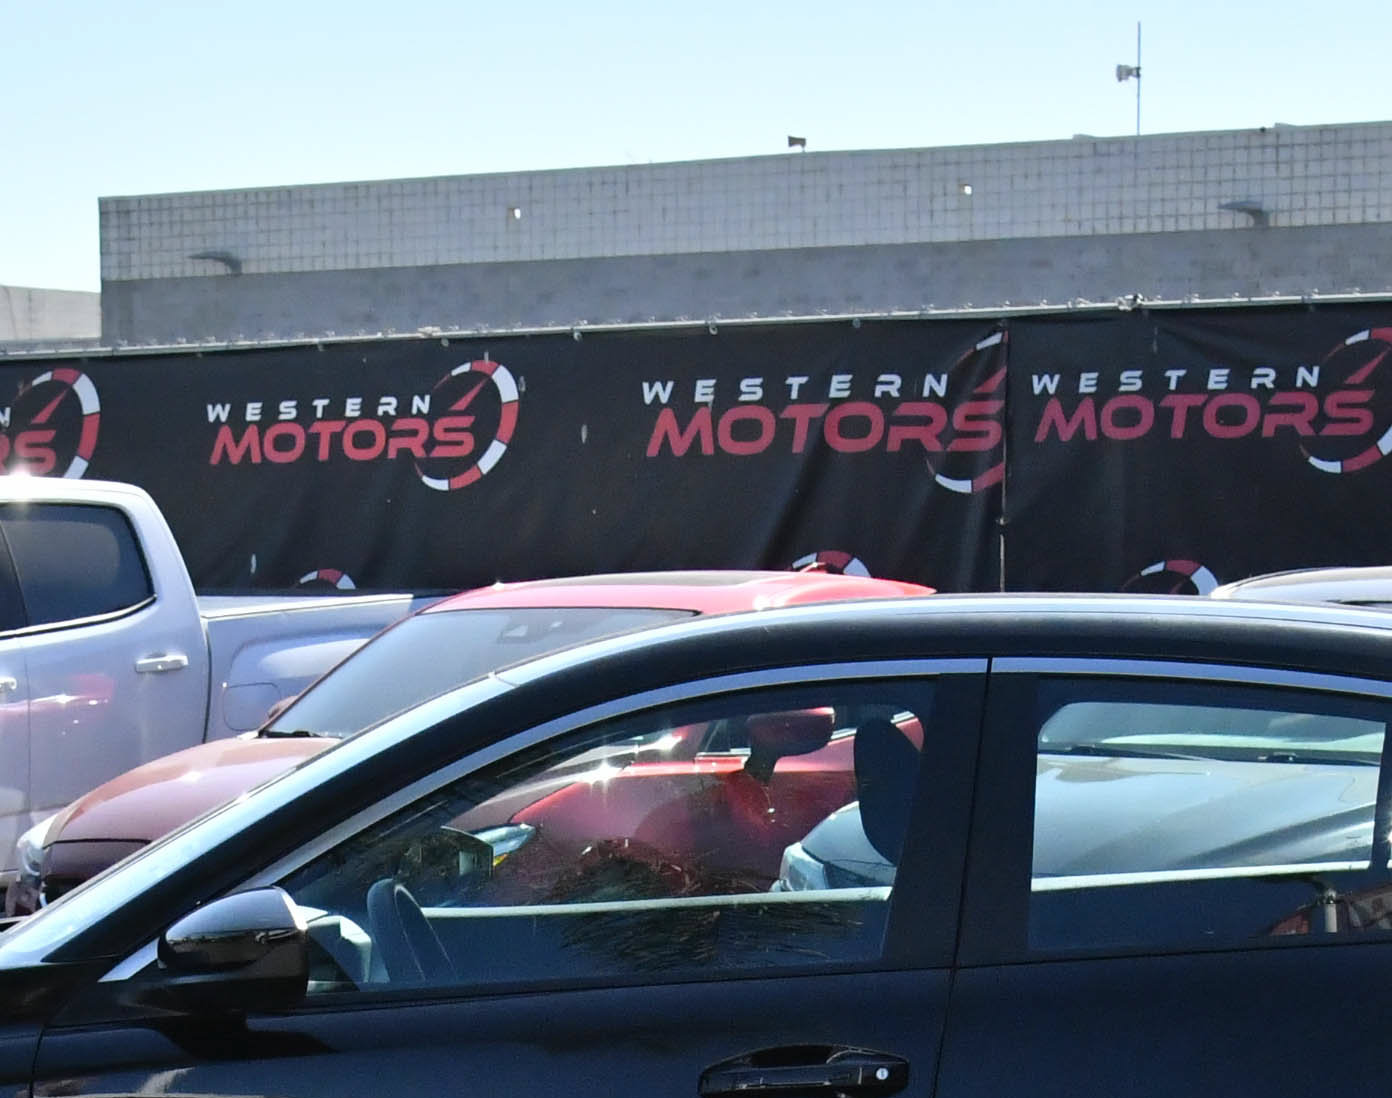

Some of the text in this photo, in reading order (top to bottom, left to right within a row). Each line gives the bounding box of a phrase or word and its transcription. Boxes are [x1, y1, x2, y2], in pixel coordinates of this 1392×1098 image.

[642, 373, 948, 405] WESTERN
[1032, 365, 1321, 395] WESTERN
[206, 394, 431, 423] WESTERN
[646, 399, 1004, 457] MOTORS
[1033, 389, 1375, 442] MOTORS
[209, 415, 476, 465] MOTORS
